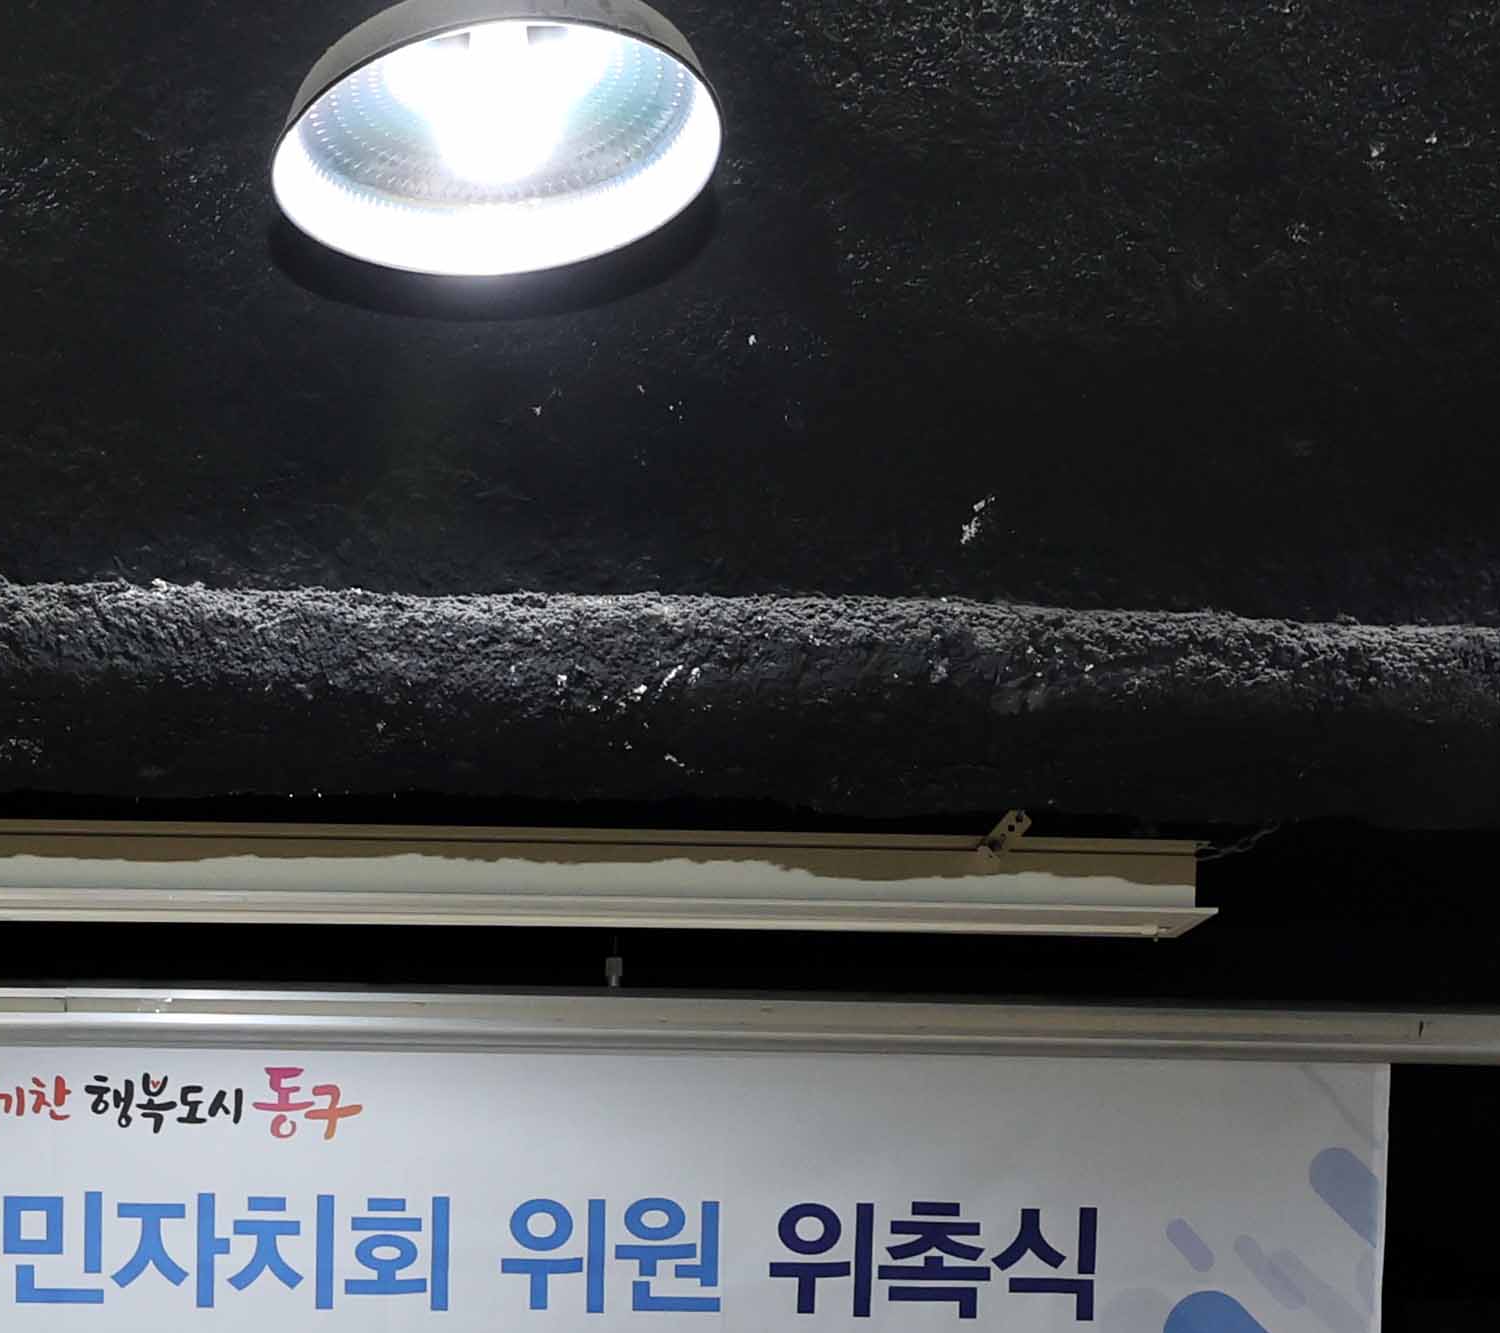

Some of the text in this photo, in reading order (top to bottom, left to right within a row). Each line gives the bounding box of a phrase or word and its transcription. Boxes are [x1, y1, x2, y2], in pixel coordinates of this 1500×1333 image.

[83, 1071, 244, 1135] 행복도시
[251, 1066, 365, 1141] 동구
[499, 1197, 723, 1314] 위원
[767, 1200, 1099, 1323] 위촉식
